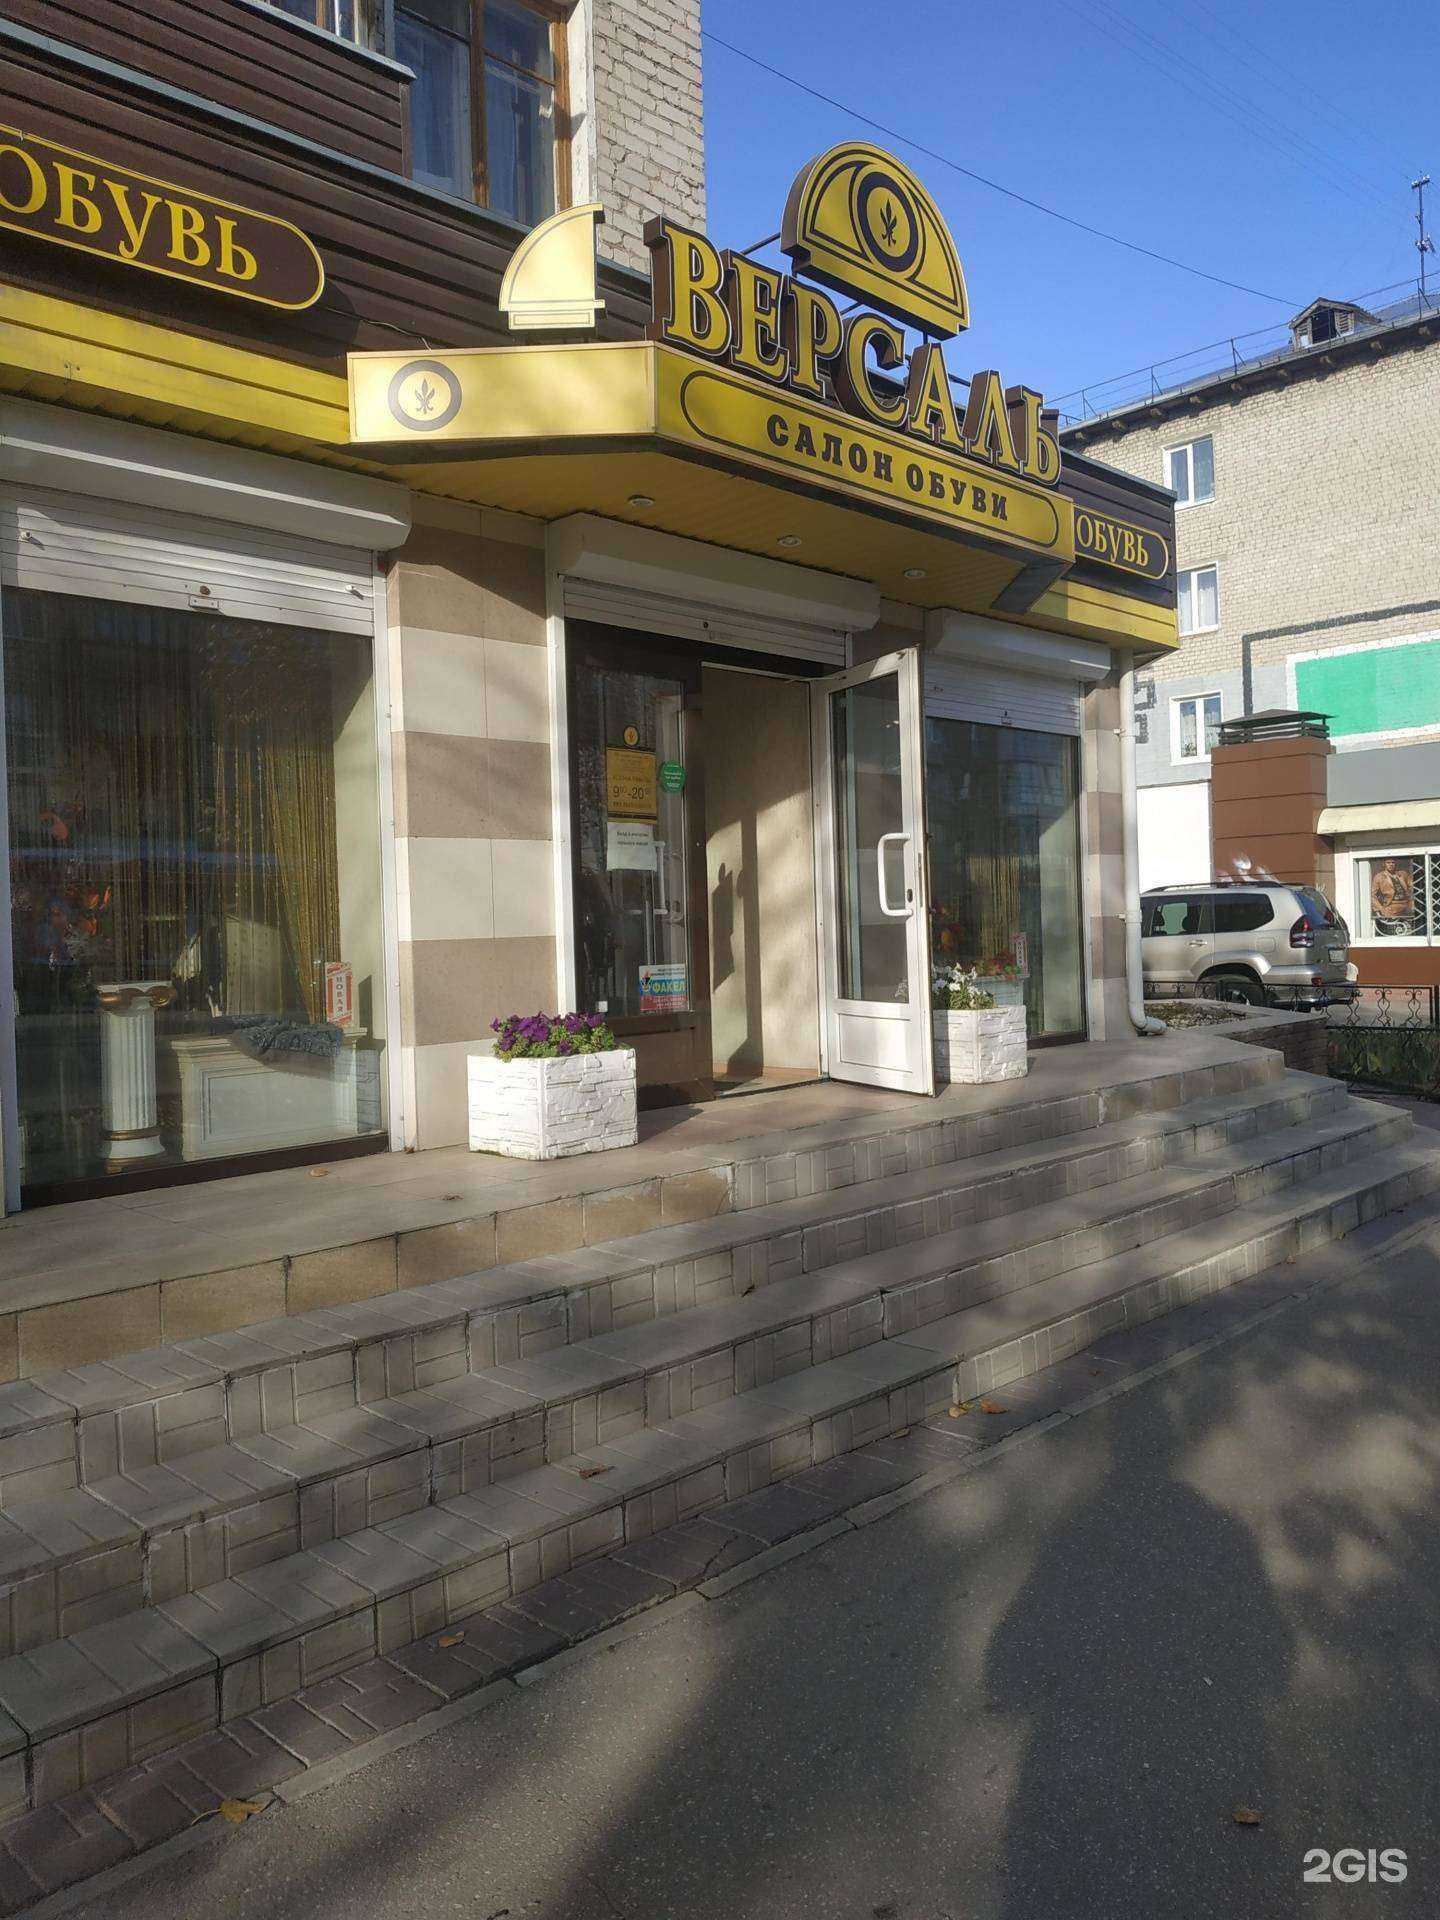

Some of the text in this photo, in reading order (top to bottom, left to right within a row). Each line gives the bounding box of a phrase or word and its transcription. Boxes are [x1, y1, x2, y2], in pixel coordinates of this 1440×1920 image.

[0, 144, 257, 280] ОБУВЬ
[656, 217, 1062, 486] ВЕРСАЛЬ
[767, 414, 1008, 522] САЛОН ОБУВИ
[1077, 515, 1148, 567] ОБУВЬ
